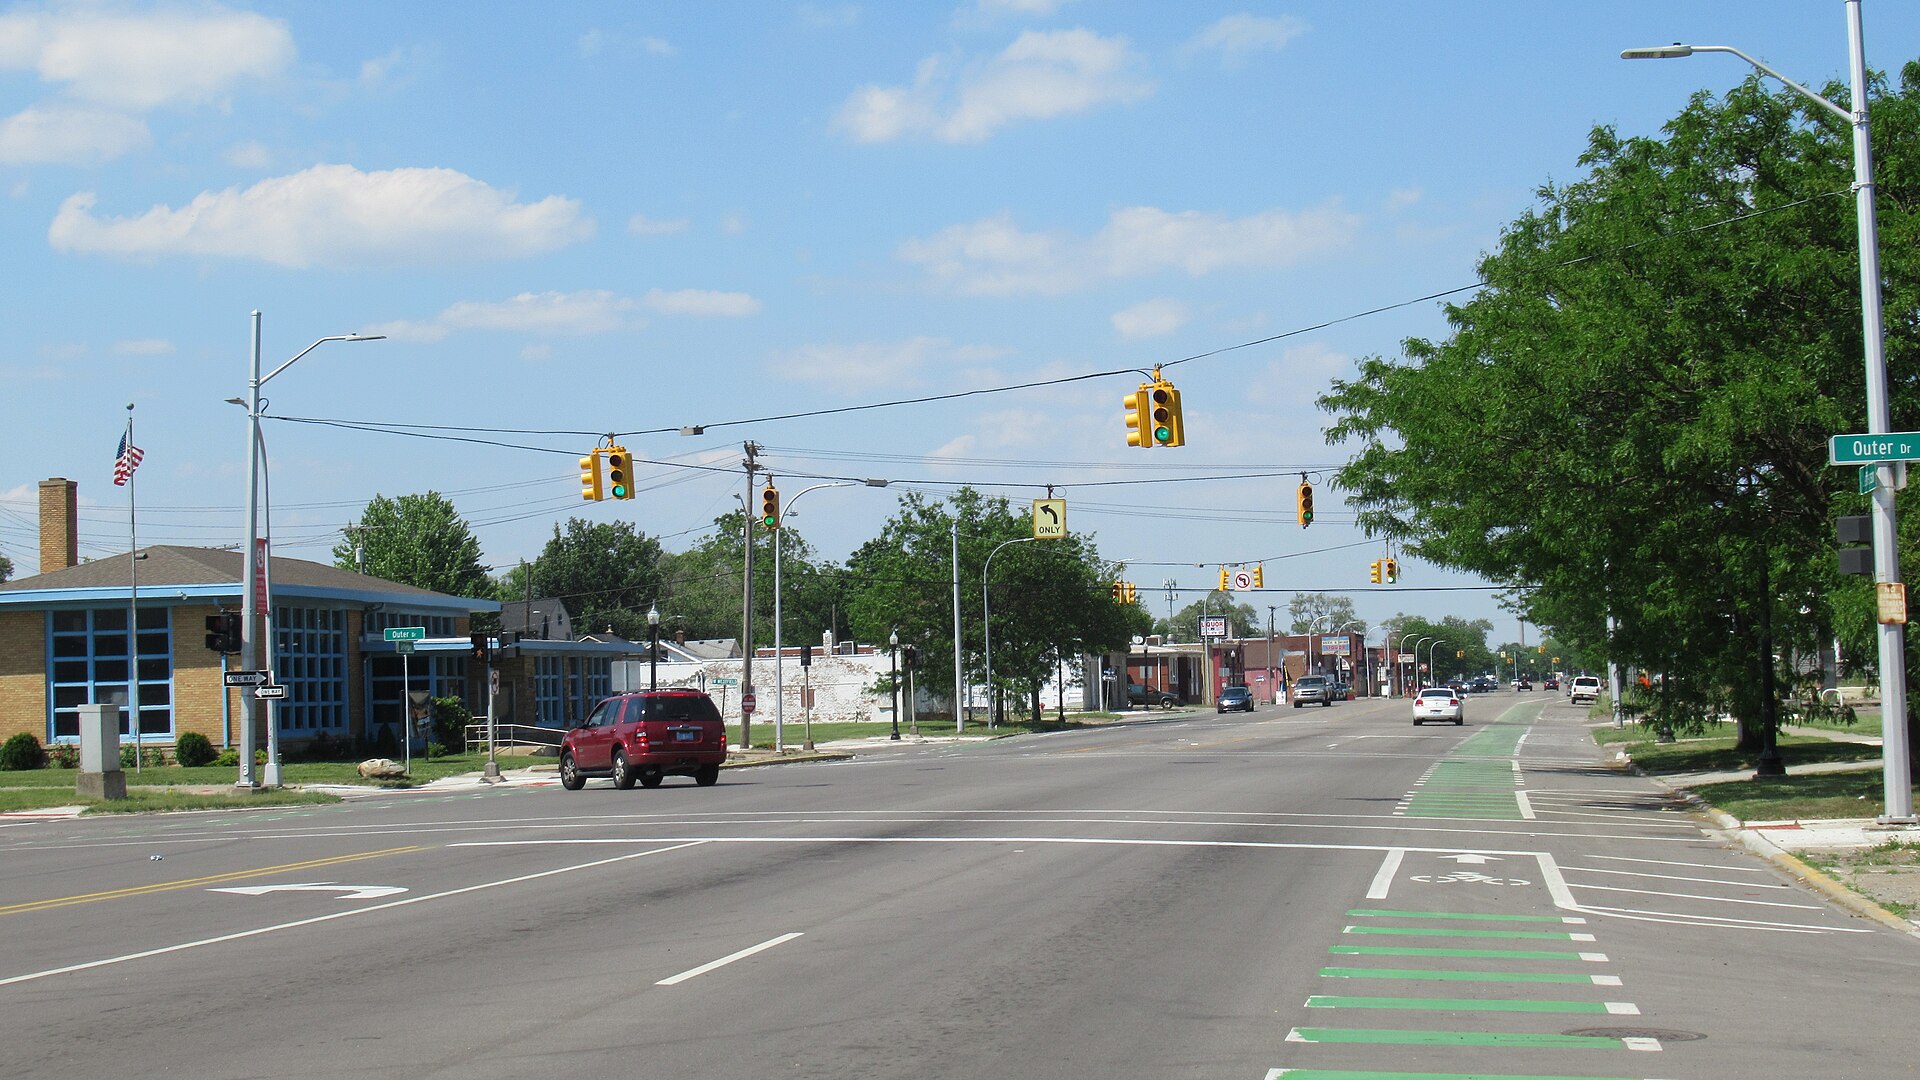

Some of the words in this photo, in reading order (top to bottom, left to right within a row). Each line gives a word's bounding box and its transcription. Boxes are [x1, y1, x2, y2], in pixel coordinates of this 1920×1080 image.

[1853, 440, 1894, 456] Outer
[1900, 443, 1912, 454] Dr
[228, 674, 243, 683] ONE
[243, 674, 257, 683] WAY
